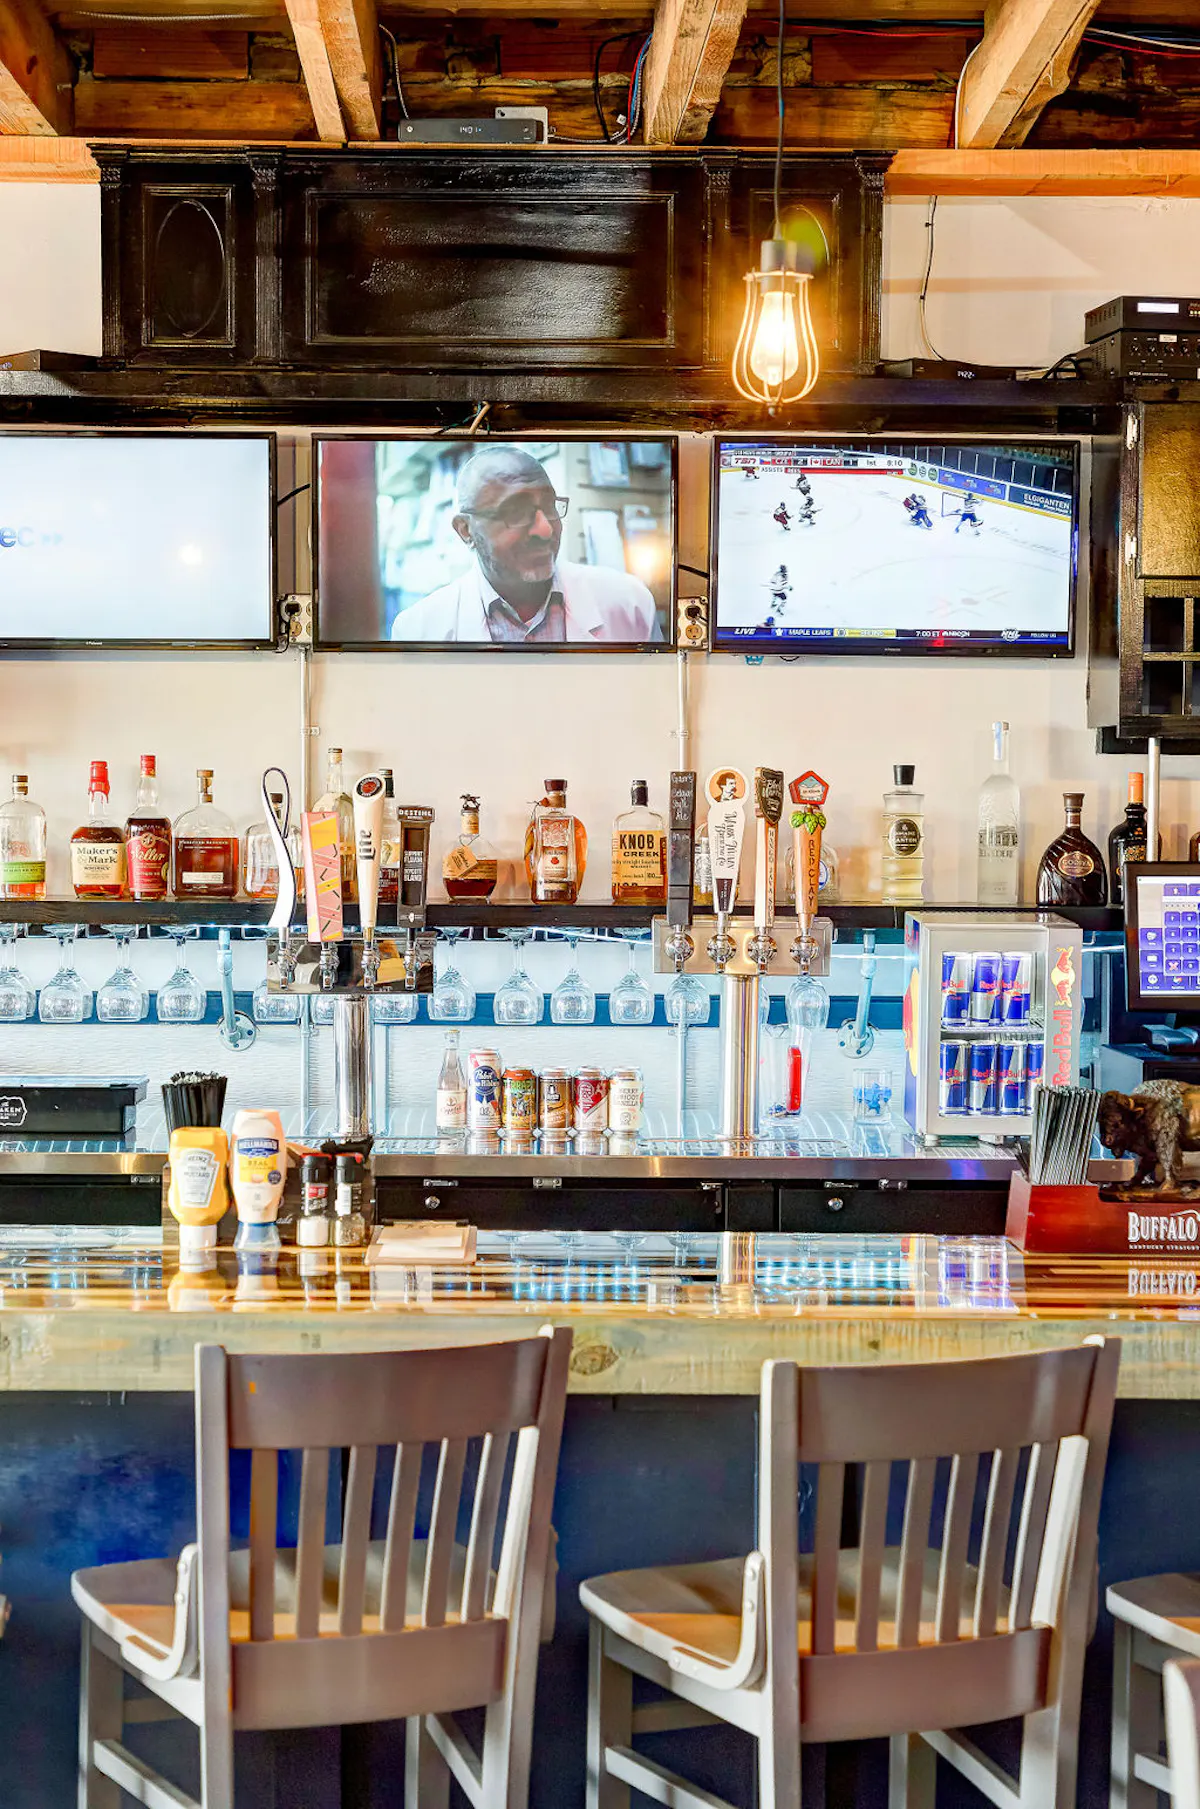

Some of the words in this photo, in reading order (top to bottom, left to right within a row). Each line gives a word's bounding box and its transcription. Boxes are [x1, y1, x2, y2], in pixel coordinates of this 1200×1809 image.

[619, 834, 655, 850] KNOB
[77, 847, 118, 855] Maker's
[88, 856, 118, 864] Mark
[807, 868, 816, 907] CLAY
[980, 980, 996, 989] Red
[1053, 1009, 1073, 1046] Bull
[972, 1069, 988, 1078] Red
[1052, 1048, 1072, 1086] Red
[1128, 1212, 1199, 1243] BUFFALO
